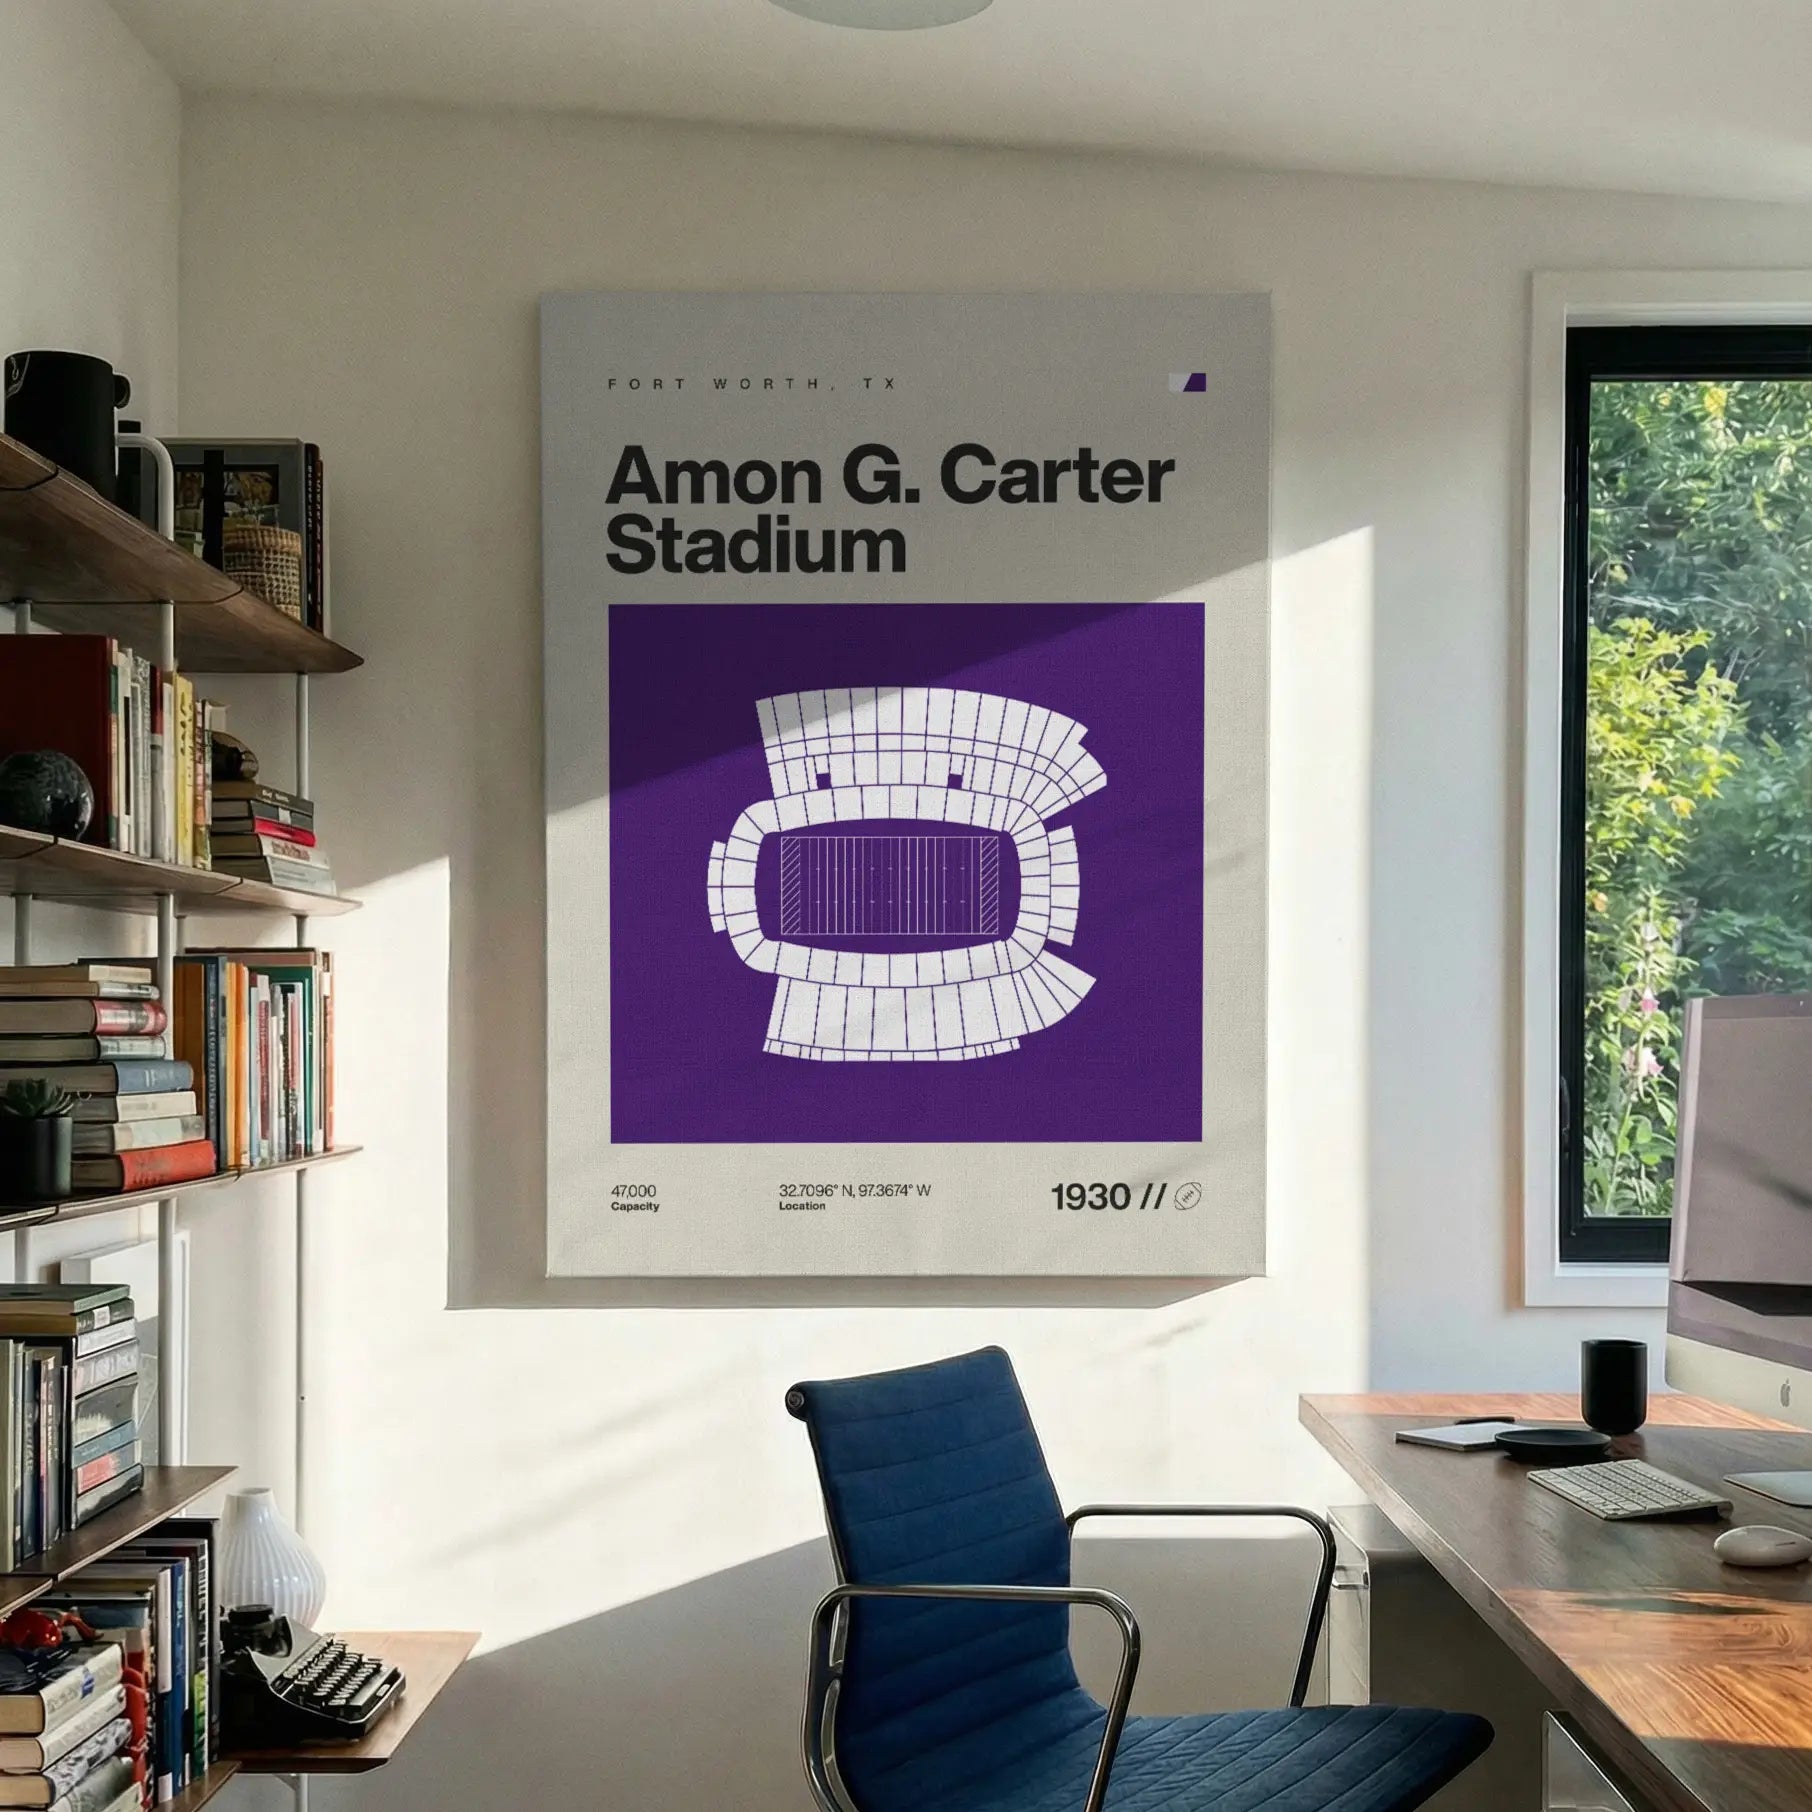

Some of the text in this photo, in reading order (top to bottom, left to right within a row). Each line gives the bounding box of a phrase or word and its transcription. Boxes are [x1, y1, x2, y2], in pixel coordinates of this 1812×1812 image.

[608, 378, 896, 392] FORT WORTH, TX
[604, 443, 1176, 505] Amon G. Carter
[606, 513, 906, 575] Stadium
[611, 1184, 657, 1199] 47,000
[779, 1184, 932, 1199] 32.7096° N, 97.3674° W
[1051, 1182, 1132, 1211] 1930
[610, 1201, 661, 1213] Capacity
[779, 1201, 827, 1211] Location
